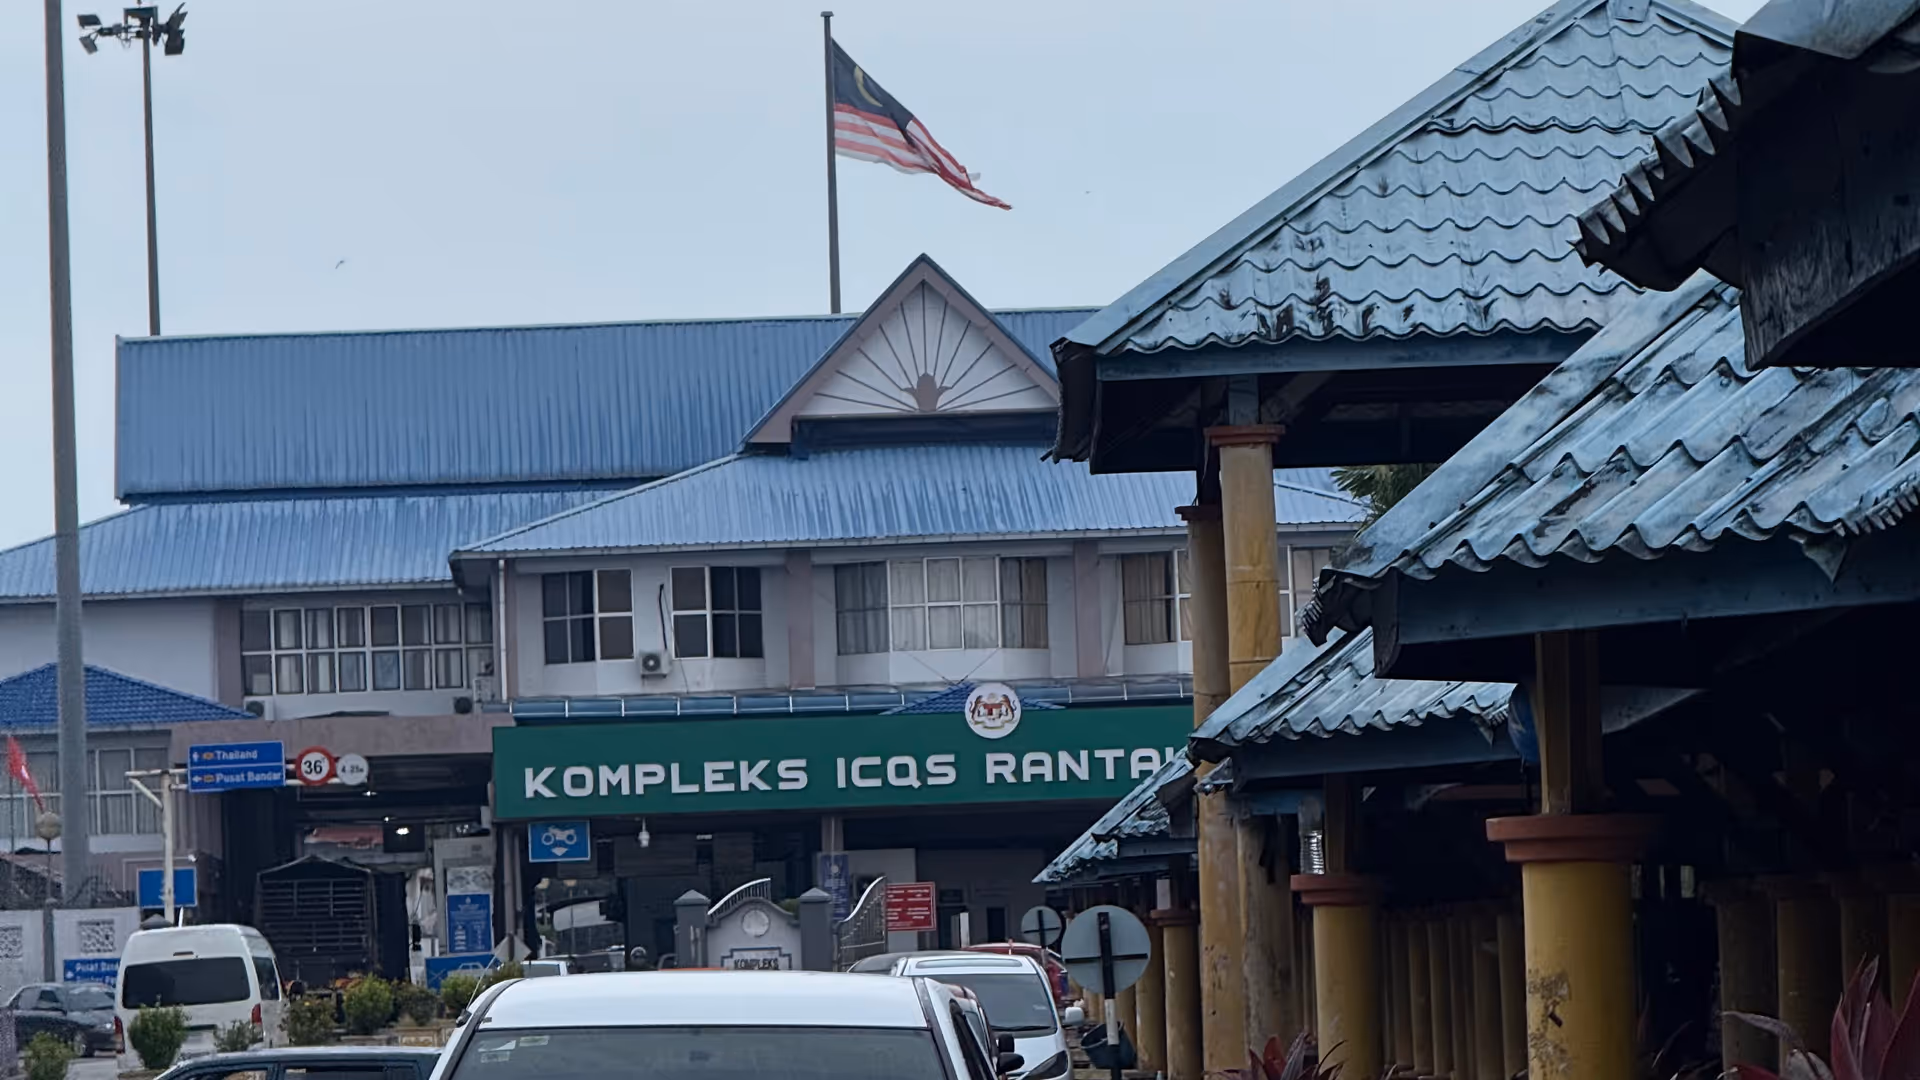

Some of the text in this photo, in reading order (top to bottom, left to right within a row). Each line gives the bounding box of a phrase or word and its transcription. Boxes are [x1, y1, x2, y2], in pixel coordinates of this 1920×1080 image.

[215, 750, 258, 760] Thailand
[216, 772, 282, 783] Pusat Bandar
[524, 758, 809, 799] KOMPLEKS
[836, 753, 957, 789] ICQS
[734, 958, 779, 970] KOMPLEKS
